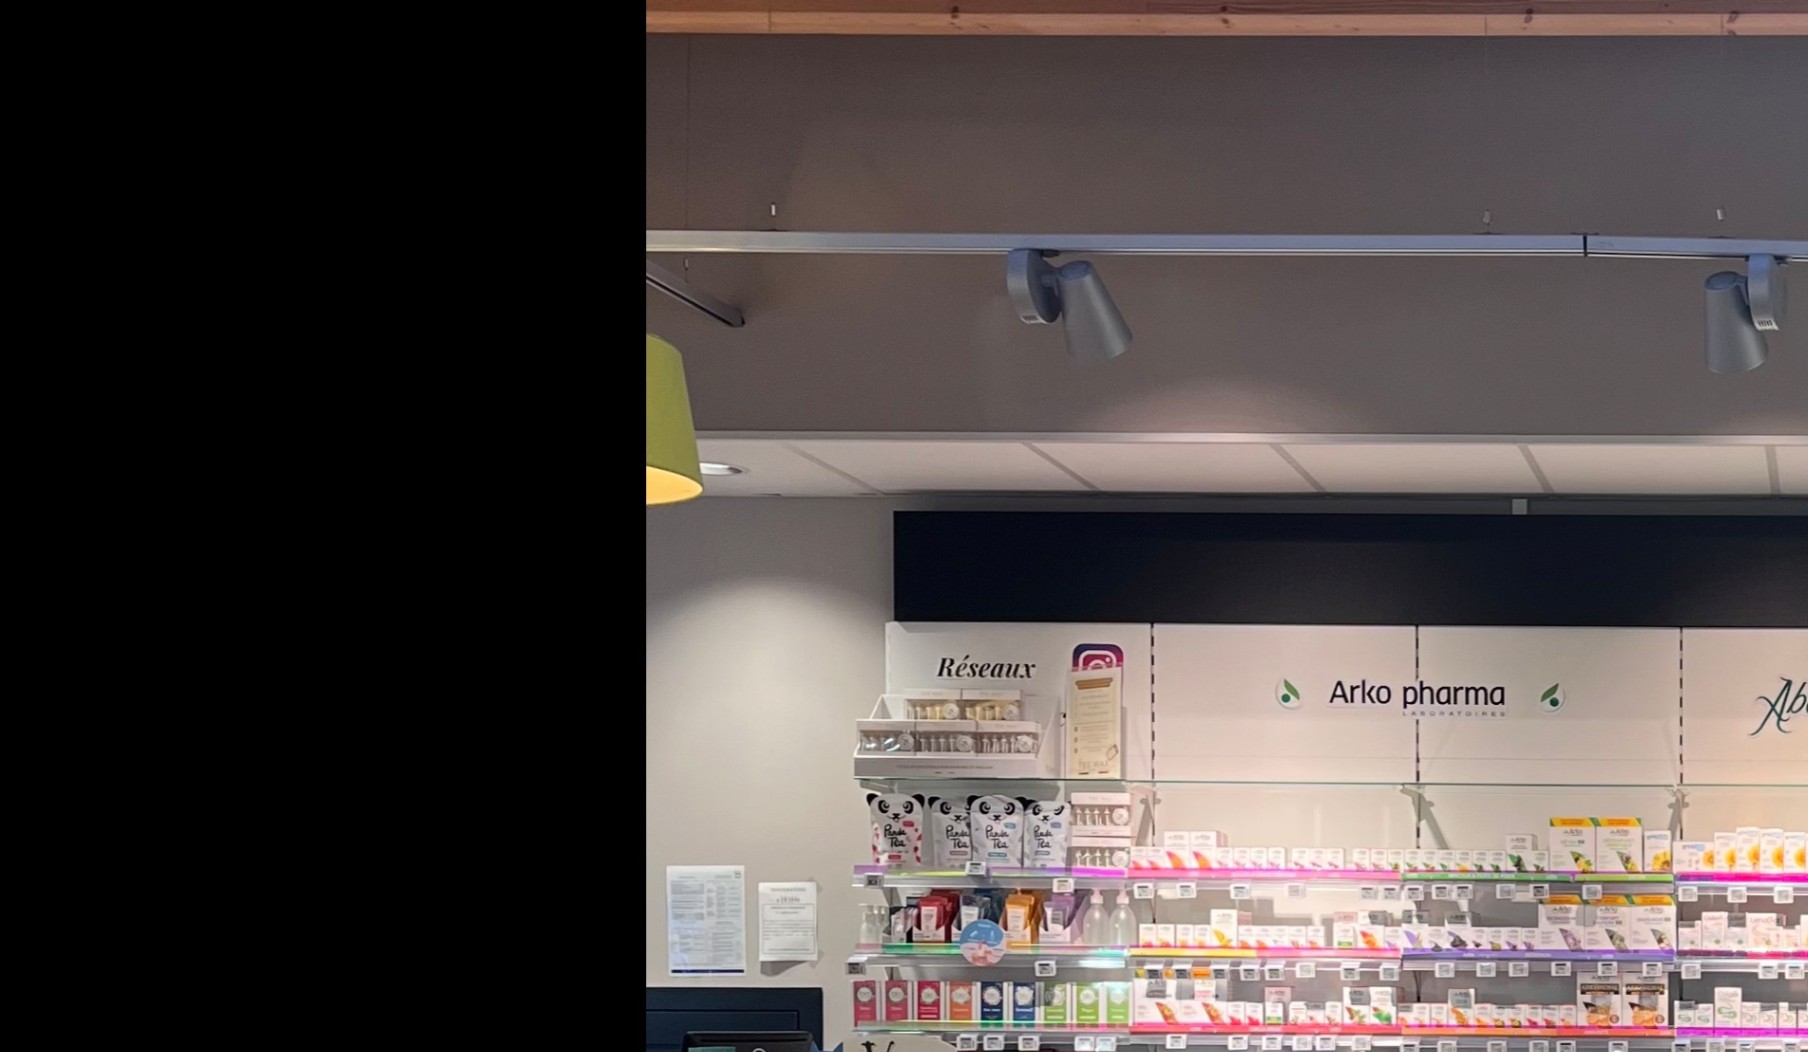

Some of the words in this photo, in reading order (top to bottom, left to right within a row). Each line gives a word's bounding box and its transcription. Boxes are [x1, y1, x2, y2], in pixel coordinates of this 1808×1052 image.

[937, 655, 1036, 678] Réseaux
[1329, 679, 1391, 704] Arko
[1402, 680, 1505, 709] pharma
